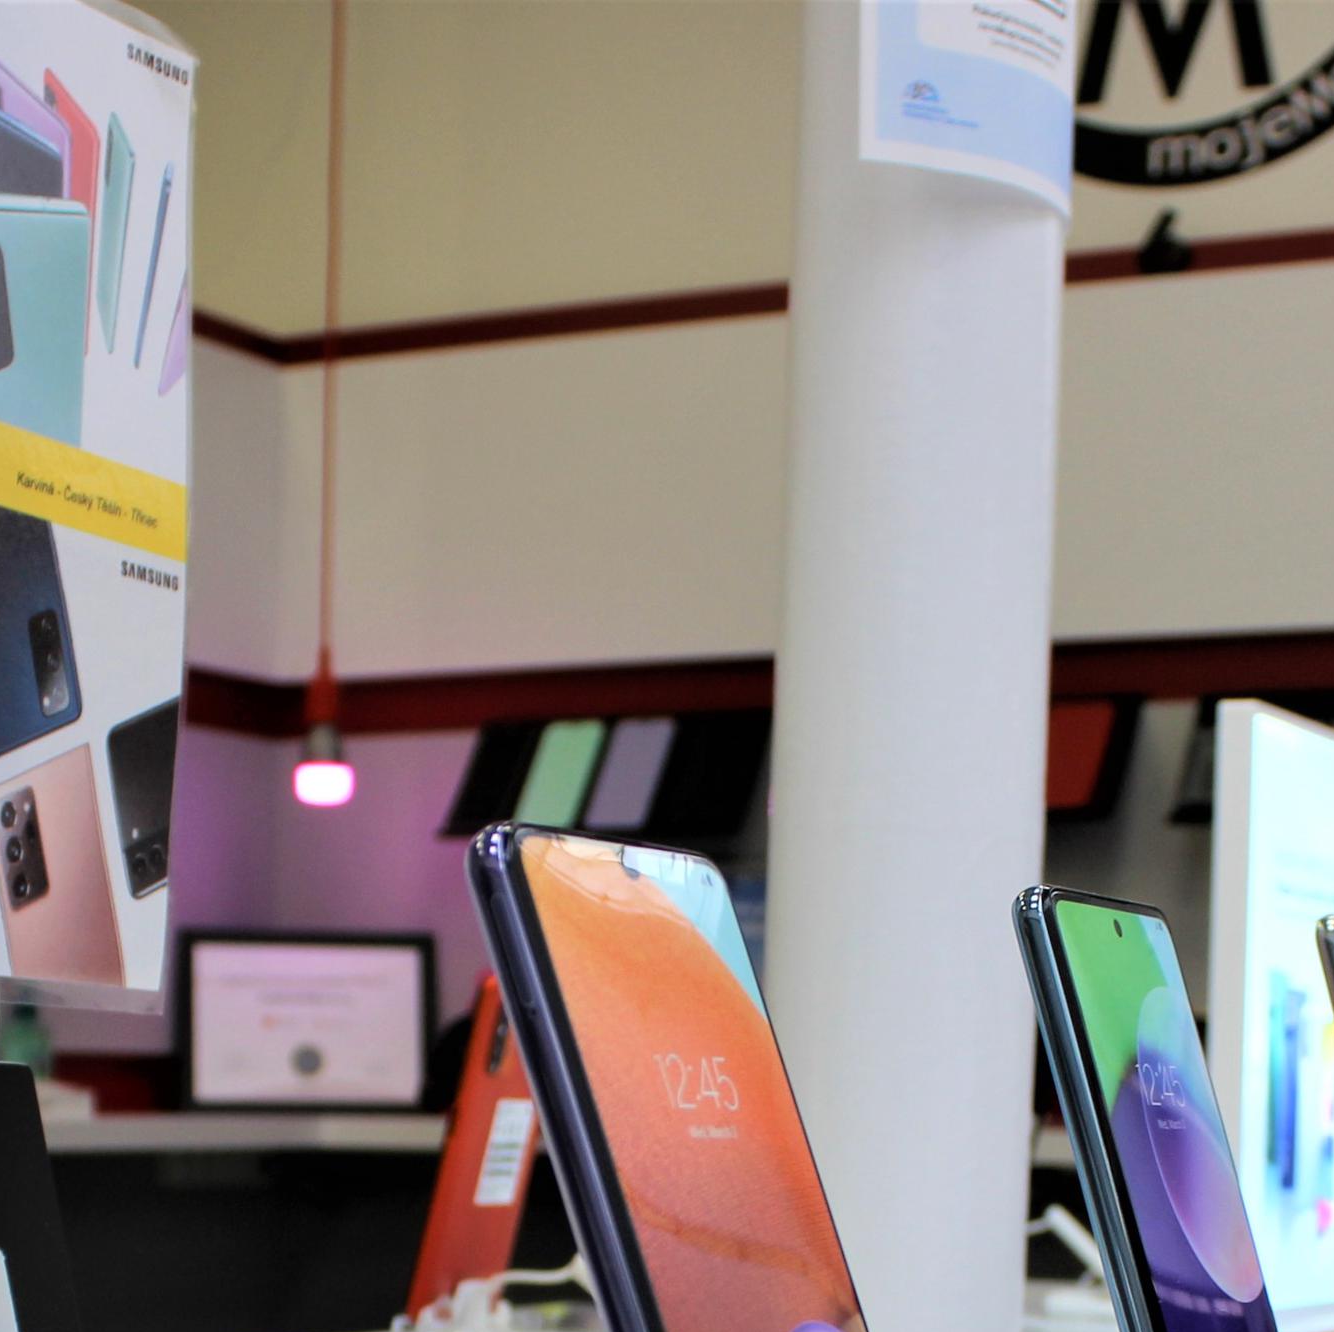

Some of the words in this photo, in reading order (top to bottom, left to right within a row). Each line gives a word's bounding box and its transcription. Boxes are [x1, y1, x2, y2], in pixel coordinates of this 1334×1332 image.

[127, 43, 188, 87] SAMSUNG
[121, 560, 179, 592] SAMSUNG
[651, 1052, 740, 1112] 12:45
[1134, 1062, 1187, 1108] 12:45
